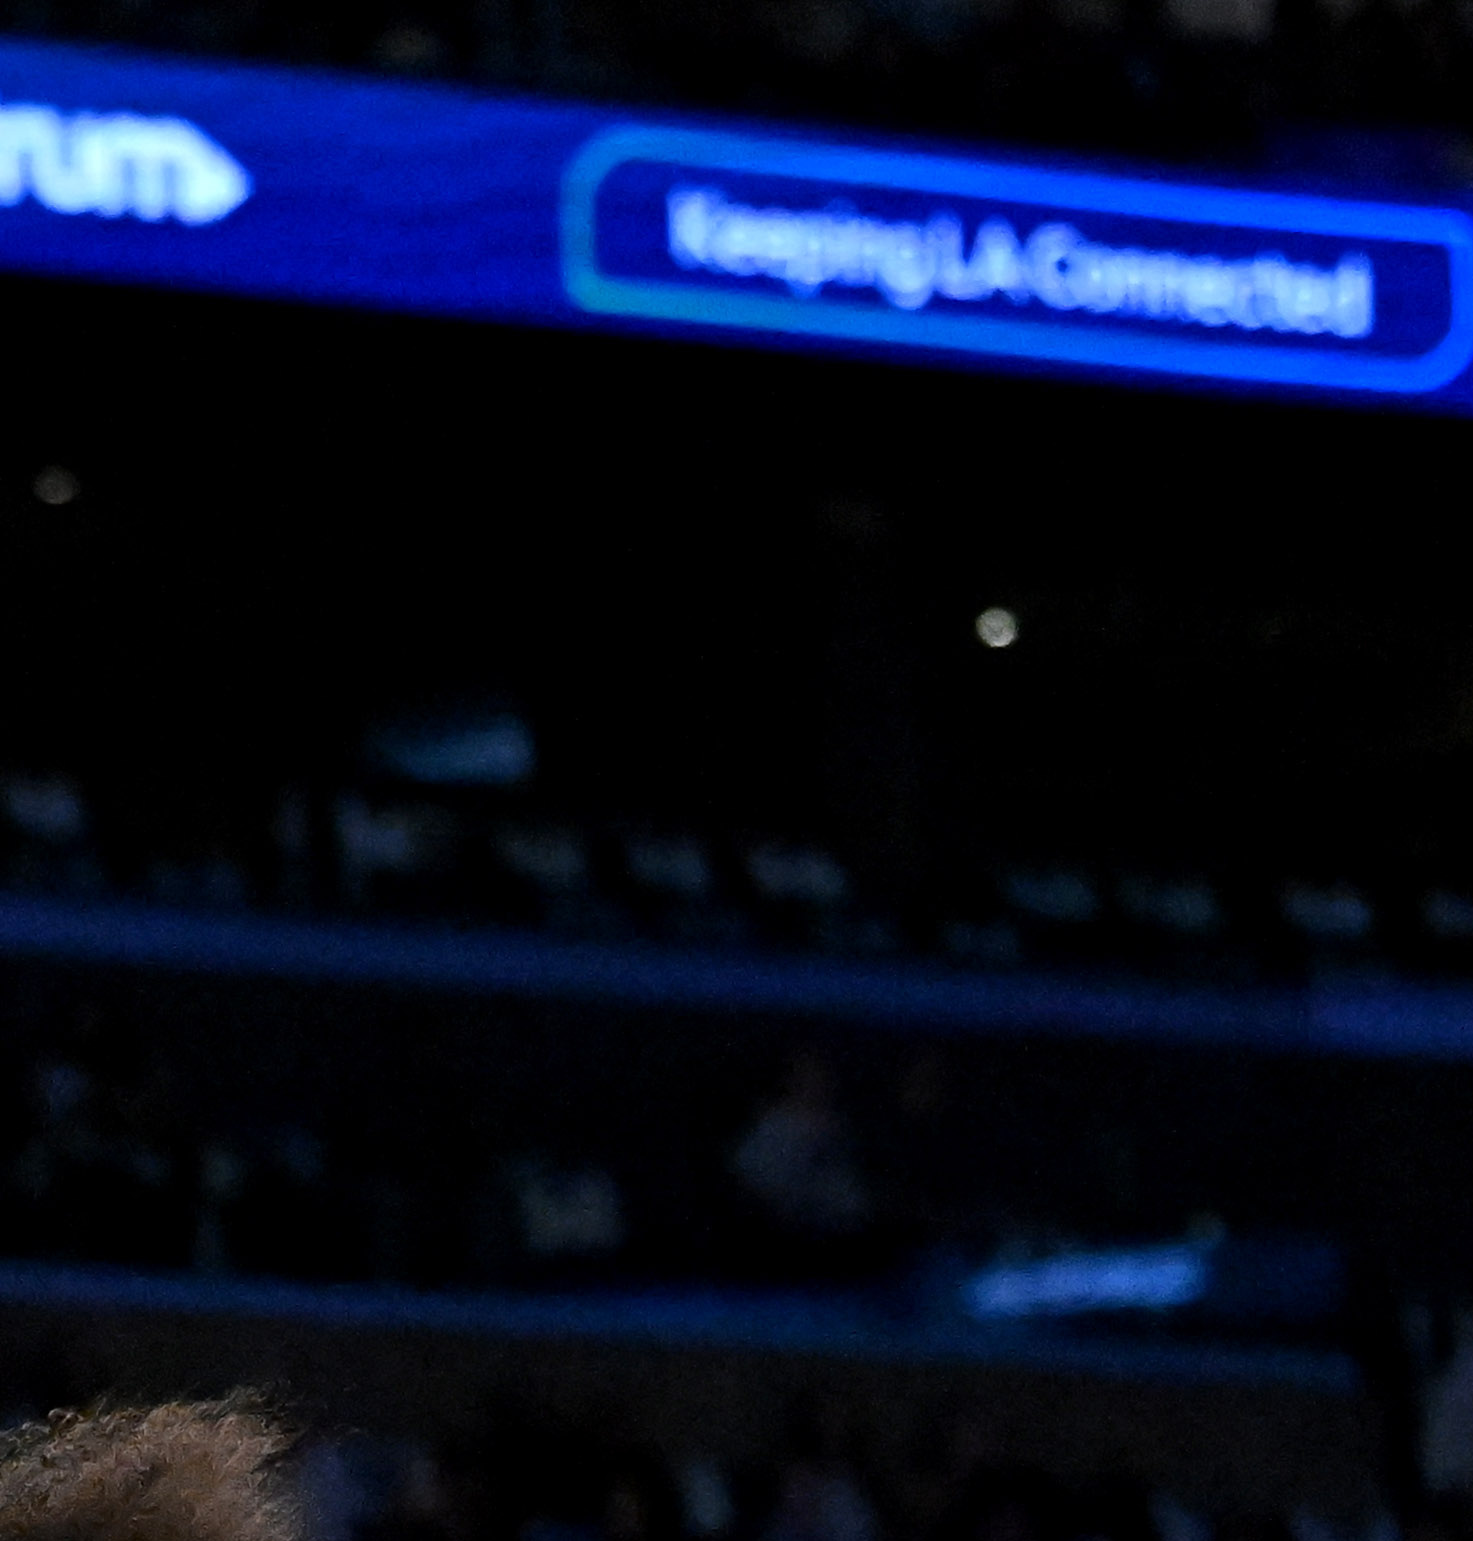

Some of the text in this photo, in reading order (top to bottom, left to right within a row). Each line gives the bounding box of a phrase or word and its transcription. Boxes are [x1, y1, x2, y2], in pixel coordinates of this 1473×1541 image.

[666, 188, 1373, 338] Keeping LA Connected
